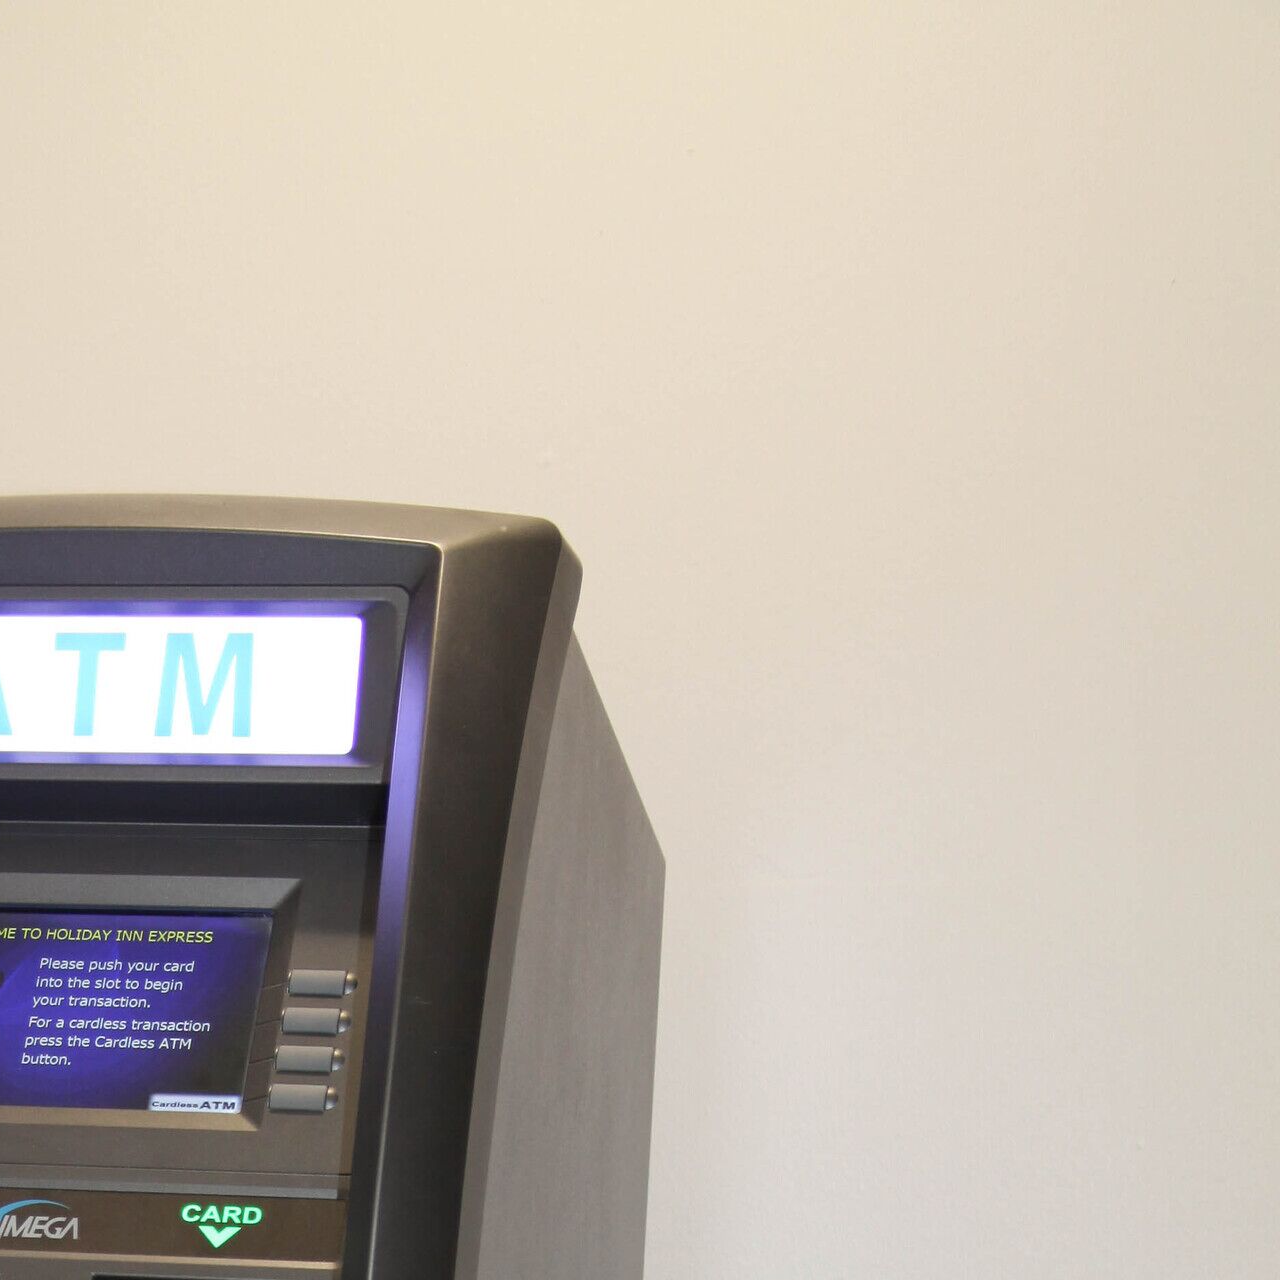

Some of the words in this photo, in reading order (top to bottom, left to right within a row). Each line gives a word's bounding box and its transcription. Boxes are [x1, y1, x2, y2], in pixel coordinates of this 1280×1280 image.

[22, 928, 42, 940] TO
[46, 928, 112, 942] HOLIDAY
[116, 930, 143, 942] INN
[148, 931, 214, 943] EXPRESS
[39, 958, 85, 971] Please
[88, 959, 123, 973] push
[127, 962, 160, 974] your
[163, 960, 195, 973] card
[35, 977, 63, 989] into
[68, 977, 90, 989] the
[94, 977, 120, 990] slot
[125, 979, 140, 990] to
[144, 978, 183, 994] begin
[32, 996, 64, 1009] your
[69, 995, 151, 1009] transaction.
[28, 1016, 52, 1028] For
[55, 1018, 64, 1028] a
[69, 1017, 127, 1031] cardless
[131, 1019, 211, 1032] transaction
[24, 1036, 62, 1049] press
[68, 1035, 90, 1047] the
[94, 1035, 155, 1049] Cardless
[158, 1038, 192, 1050] ATM
[21, 1053, 72, 1066] button.
[181, 1204, 263, 1225] CARD
